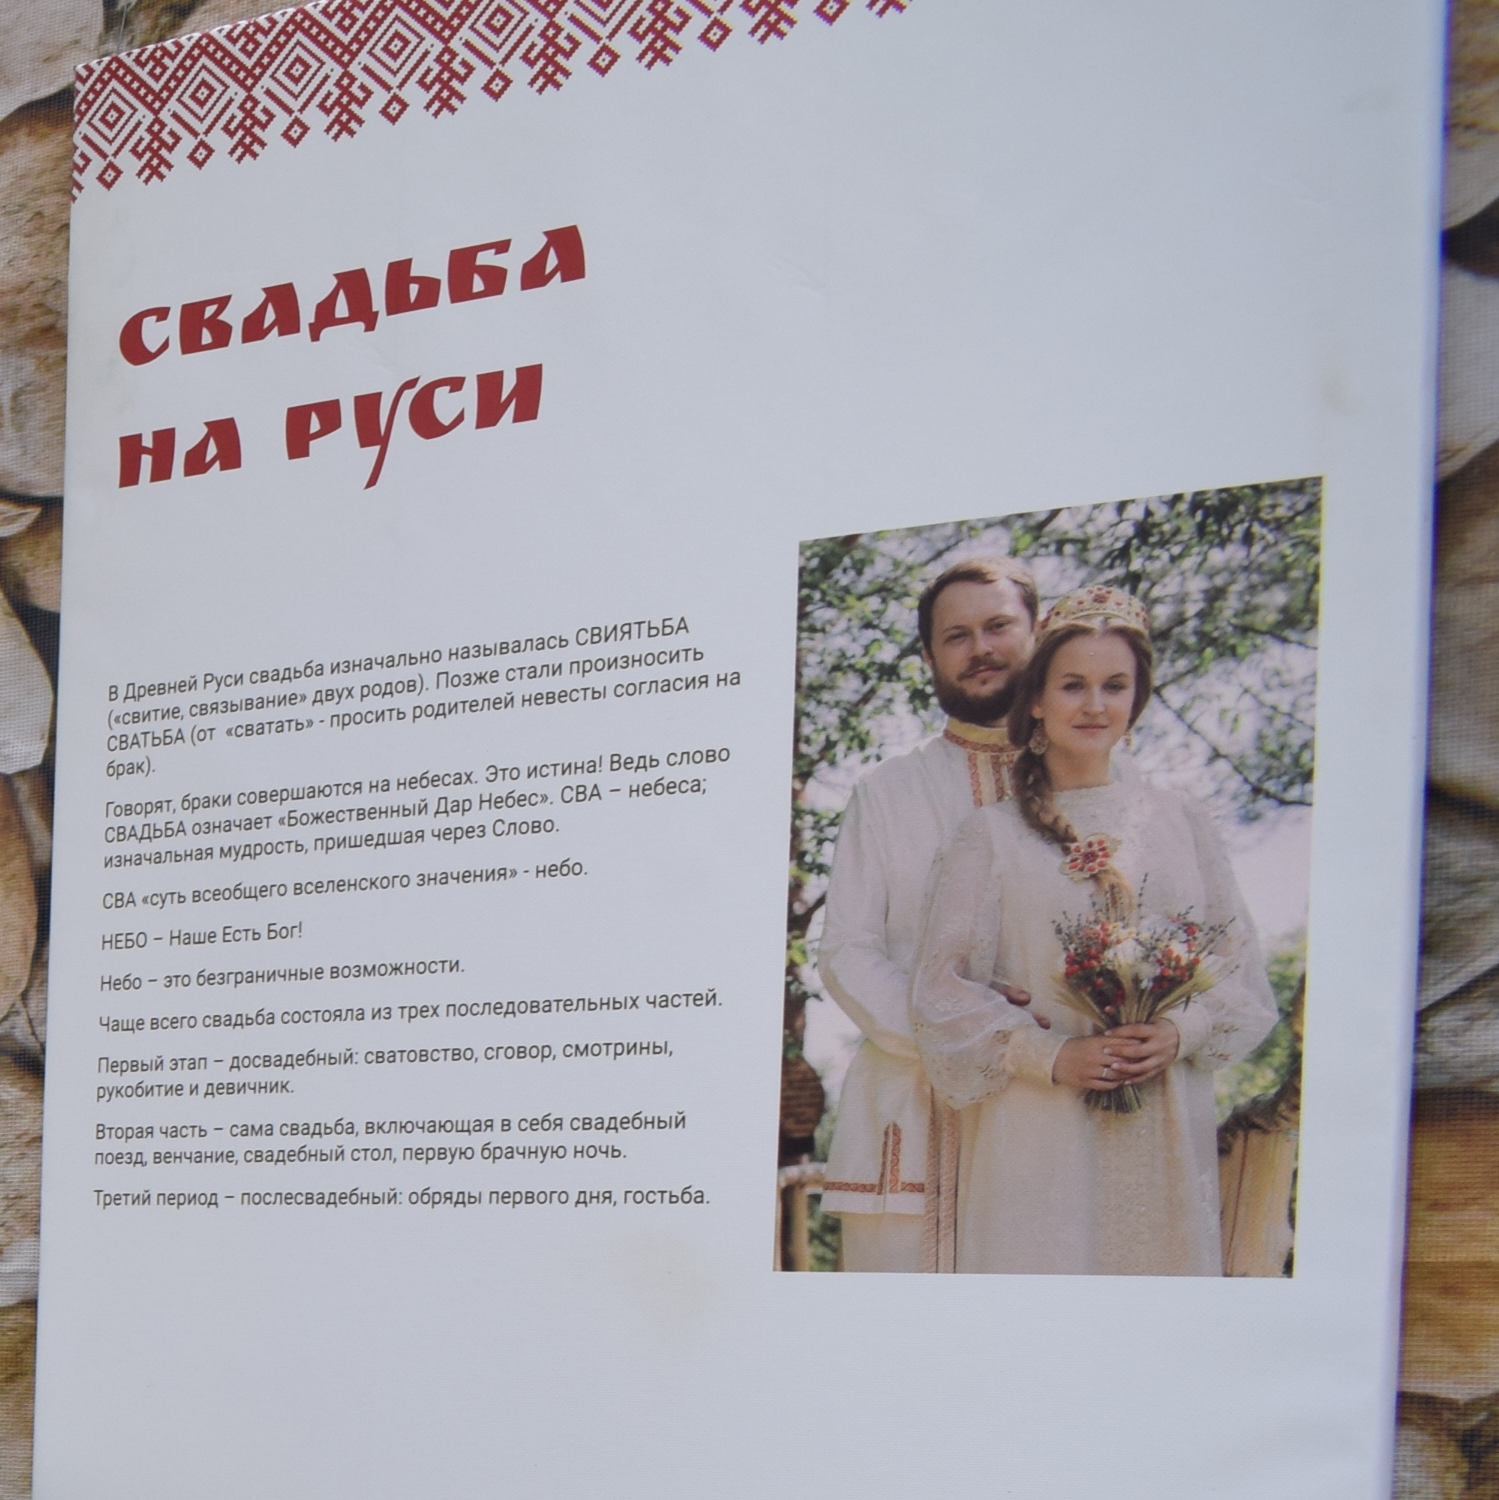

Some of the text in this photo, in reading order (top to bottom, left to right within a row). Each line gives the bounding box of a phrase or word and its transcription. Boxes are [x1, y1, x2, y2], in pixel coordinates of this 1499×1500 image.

[118, 223, 587, 367] СВАДЬБА
[118, 363, 544, 491] НА РУСИ
[108, 616, 690, 704] В Древней Руси свадьба изначально называлась СВИЯТЬБА
[107, 647, 704, 731] («свитие, связывание» двух родов). Позже стали произносить
[107, 671, 738, 752] СВАТЬБА (от «сватать» просить родителей невесты согласия на
[105, 747, 730, 819] Говорят, браки совершаются на небесах. Это истина! Ведь слово
[106, 755, 155, 781] брак).
[104, 776, 707, 844] СВАДЬБА означает «Божественный Дар Небес». СВА небеса;
[104, 818, 559, 868] изначальная мудрость, пришедшая через Слово.
[102, 857, 588, 910] СВА «суть всеобщего вселенского значения» небо.
[101, 921, 303, 950] НЕБО Наше Есть Бог!
[100, 959, 465, 991] Небо это безграничные возможности.
[99, 988, 722, 1034] Чаще всего свадьба состояла из трех последовательных частей.
[98, 1040, 673, 1077] Первый этап досвадебный: сватовство, сговор, смотрины,
[96, 1080, 294, 1103] рукобитие и девичник.
[95, 1110, 686, 1143] Вторая часть сама свадьба, включающая в себя свадебный
[94, 1141, 627, 1168] поезд, венчание, свадебный стол, первую брачную ночь.
[93, 1185, 710, 1210] Третий период послесвадебный: обряды первого дня, гостьба.
